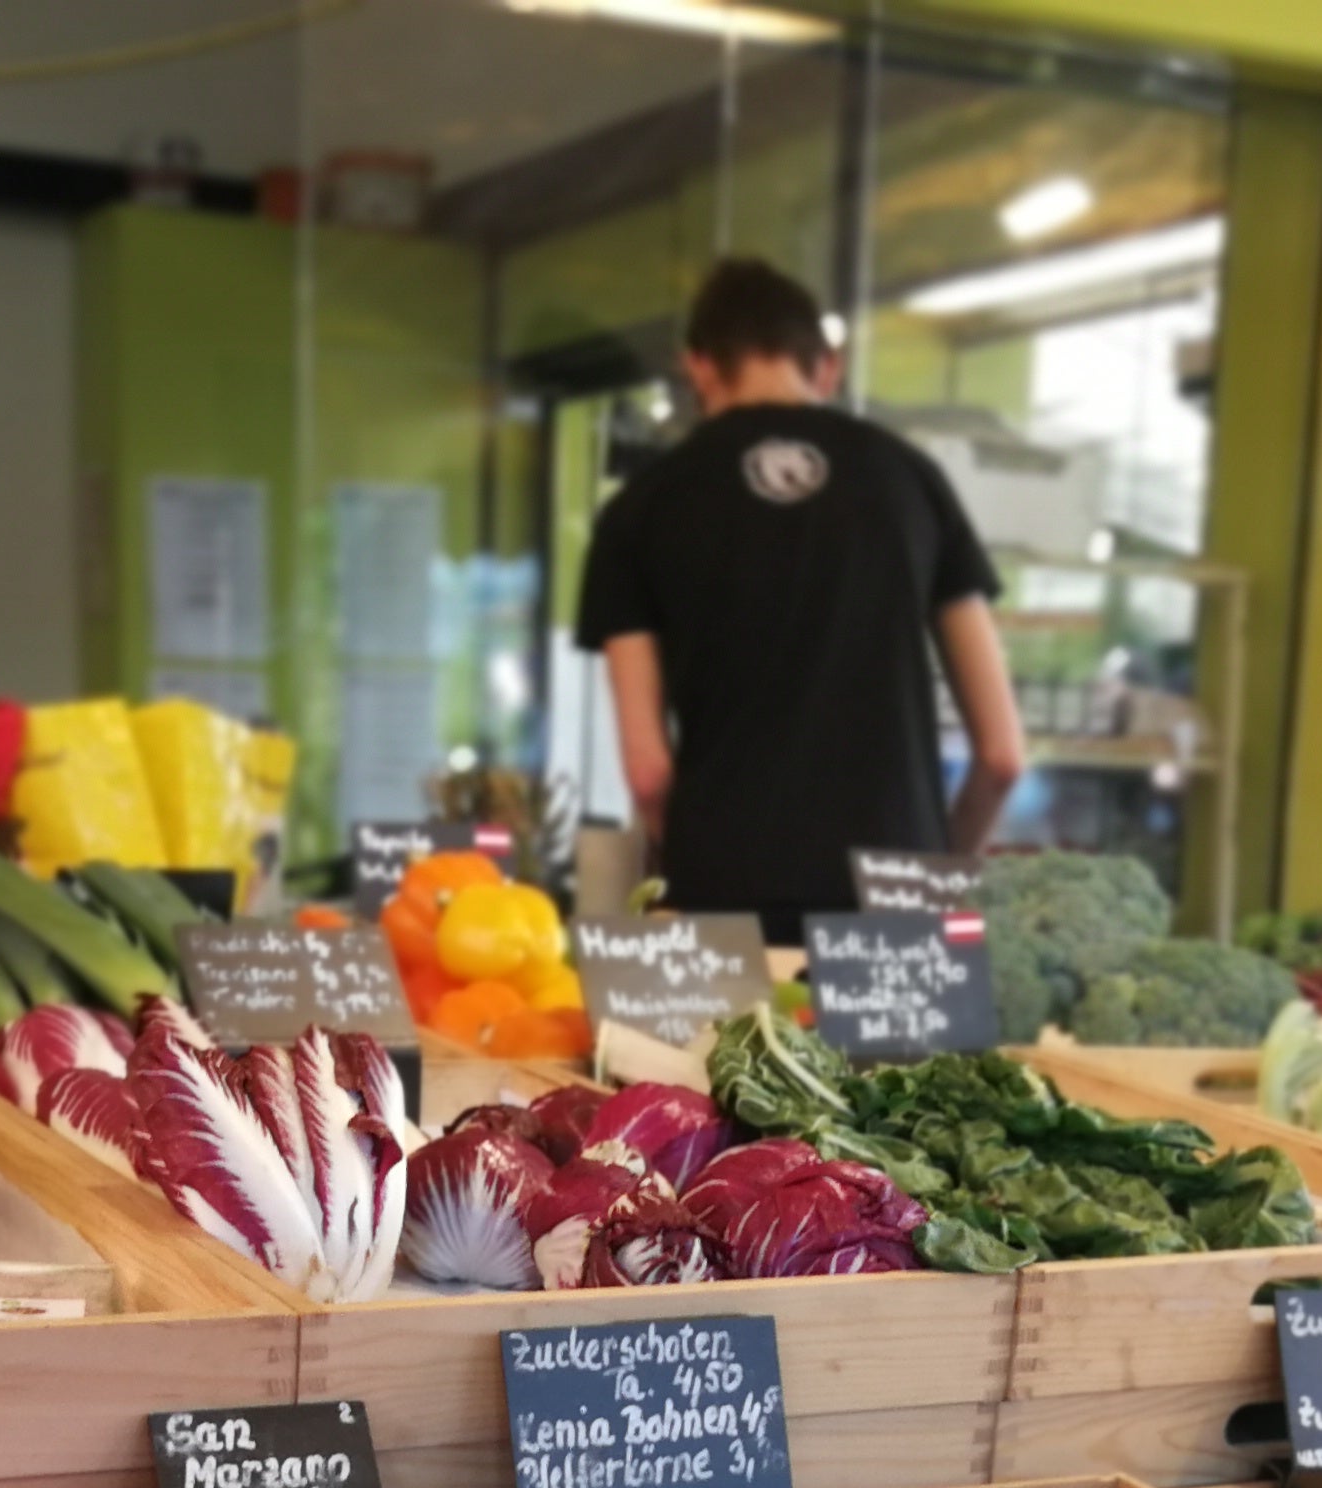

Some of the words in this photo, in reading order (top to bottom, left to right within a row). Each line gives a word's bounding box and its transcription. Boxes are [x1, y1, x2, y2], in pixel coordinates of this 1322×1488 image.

[577, 920, 698, 966] Mangold
[508, 1322, 736, 1372] Zuckerschoten
[672, 1360, 744, 1408] 4,50
[165, 1413, 257, 1457] San
[517, 1404, 617, 1454] Kenia
[620, 1398, 738, 1445] Bohnen
